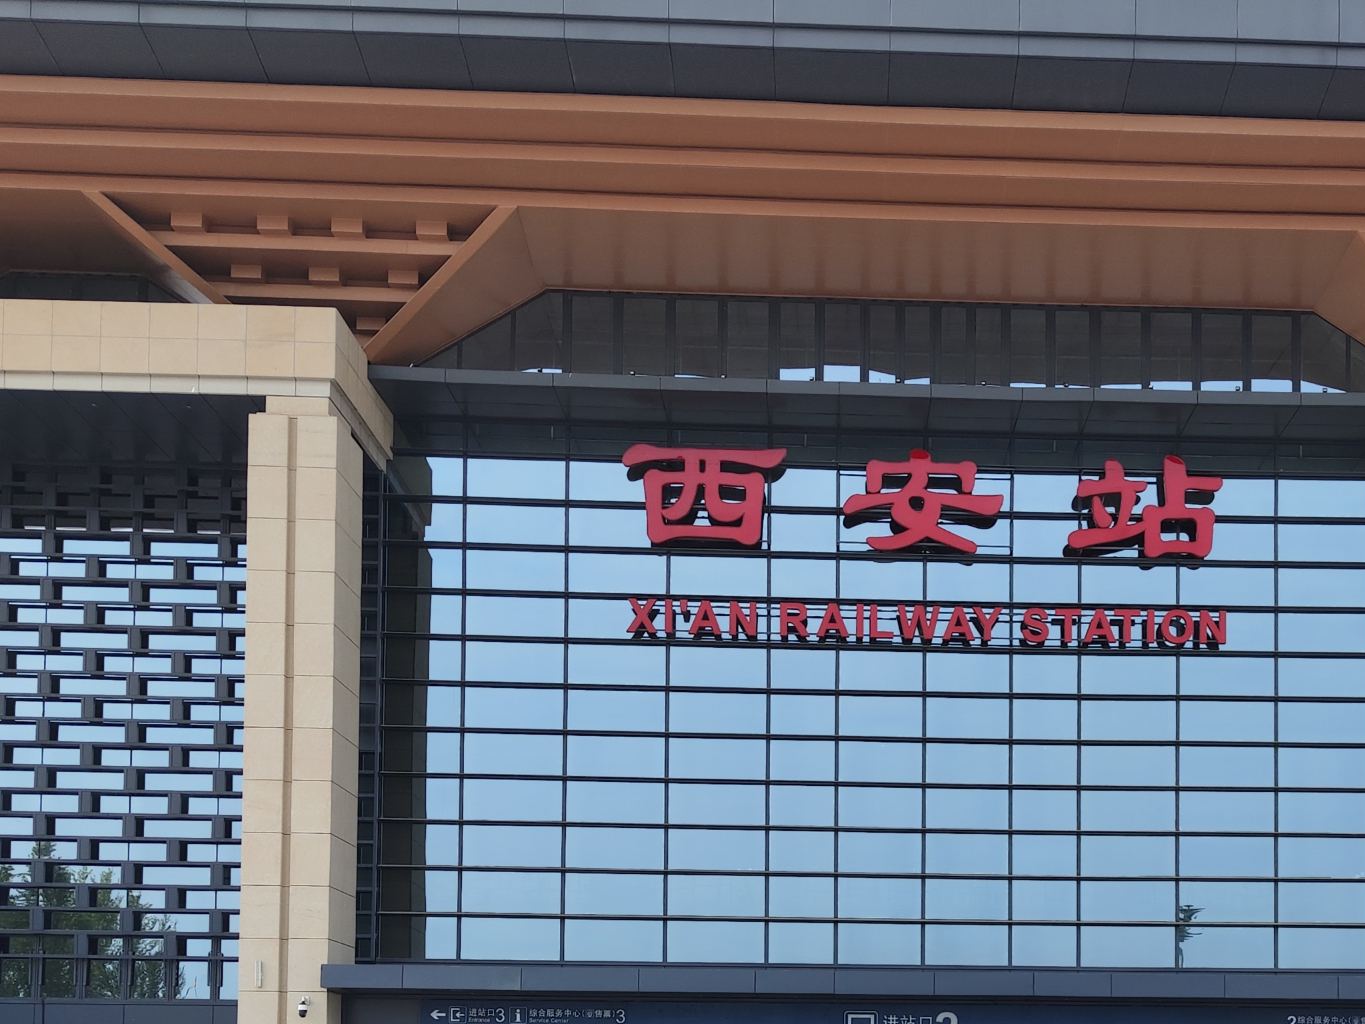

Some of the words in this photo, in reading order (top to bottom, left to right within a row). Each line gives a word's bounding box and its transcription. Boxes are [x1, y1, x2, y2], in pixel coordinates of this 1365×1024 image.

[622, 444, 1223, 558] 西安站
[628, 599, 758, 637] XI'AN
[779, 602, 1002, 642] RAILWAY
[1021, 607, 1227, 645] STATION
[495, 1007, 505, 1023] 3
[616, 1009, 626, 1024] 3
